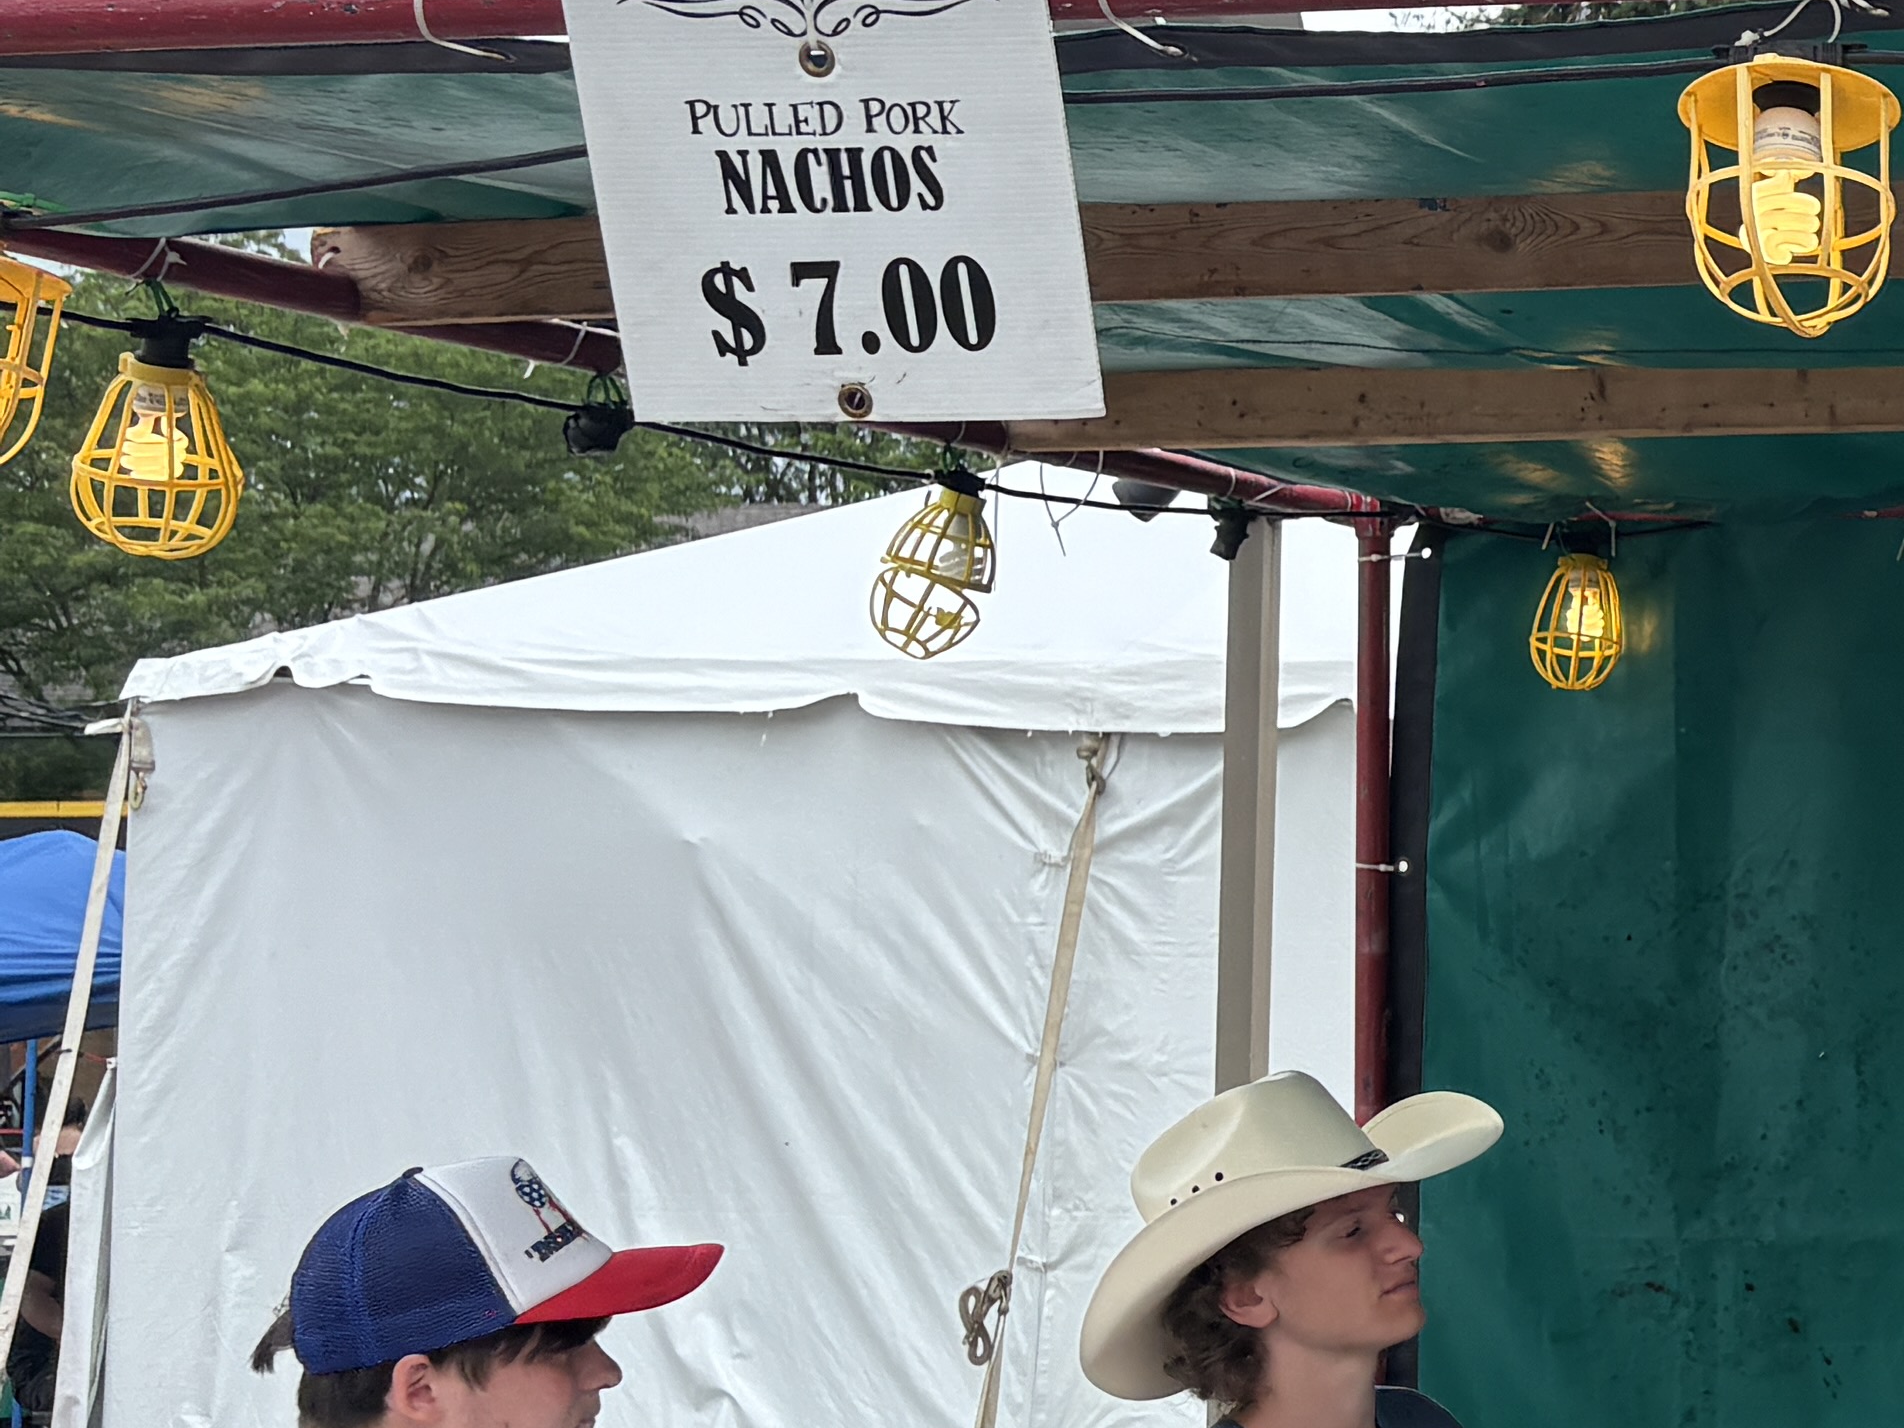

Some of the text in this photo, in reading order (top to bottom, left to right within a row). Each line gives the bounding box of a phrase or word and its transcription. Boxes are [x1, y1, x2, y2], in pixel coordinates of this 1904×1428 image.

[685, 98, 964, 137] PULLED PORK
[715, 145, 943, 215] NACHOS
